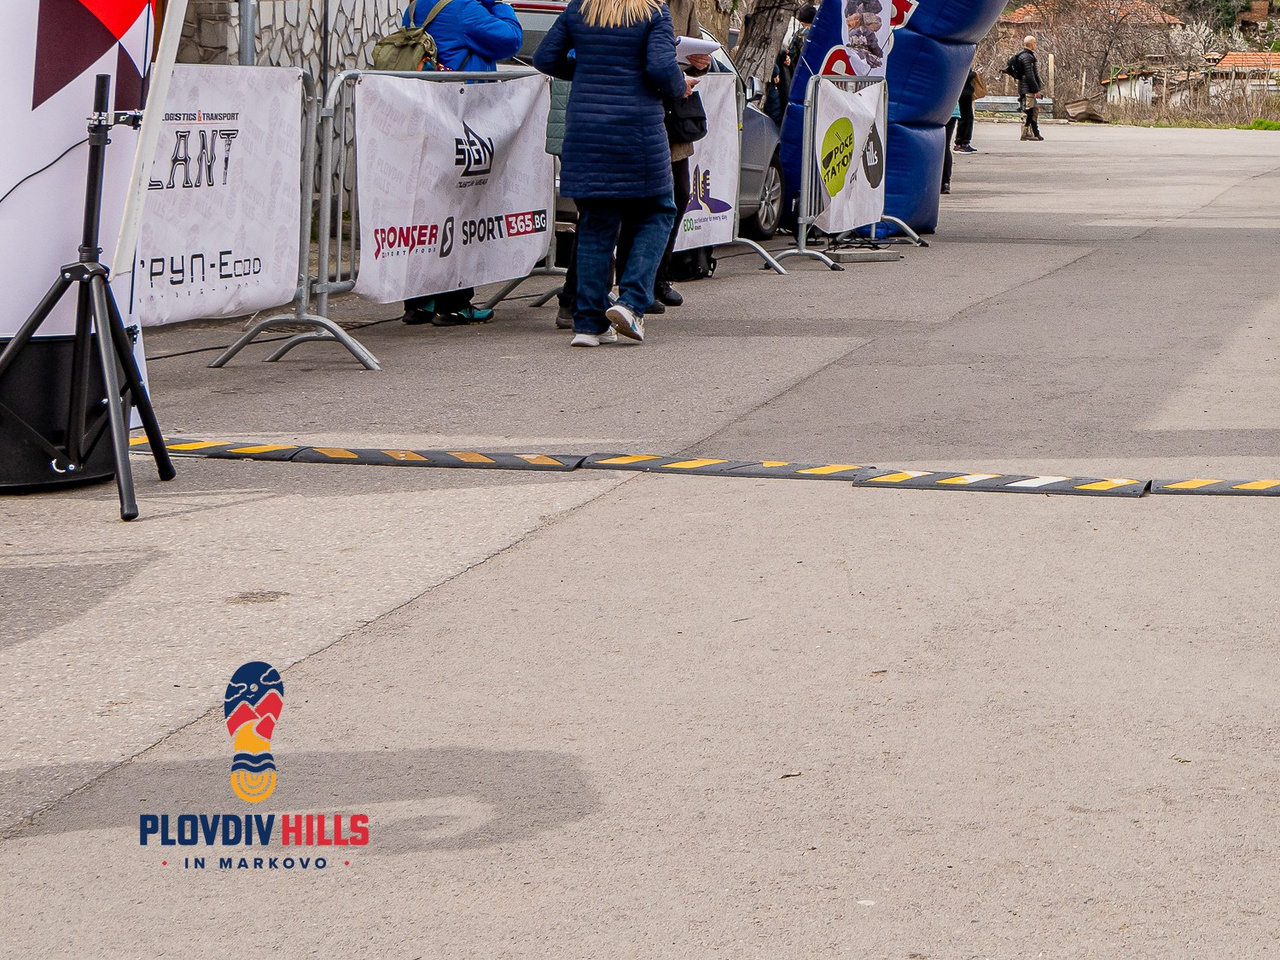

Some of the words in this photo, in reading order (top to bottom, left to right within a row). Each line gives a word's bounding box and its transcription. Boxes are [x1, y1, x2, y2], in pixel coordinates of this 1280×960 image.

[161, 113, 197, 122] OGISTICS
[202, 113, 239, 121] TRANSPORT
[374, 224, 438, 260] SPONSER
